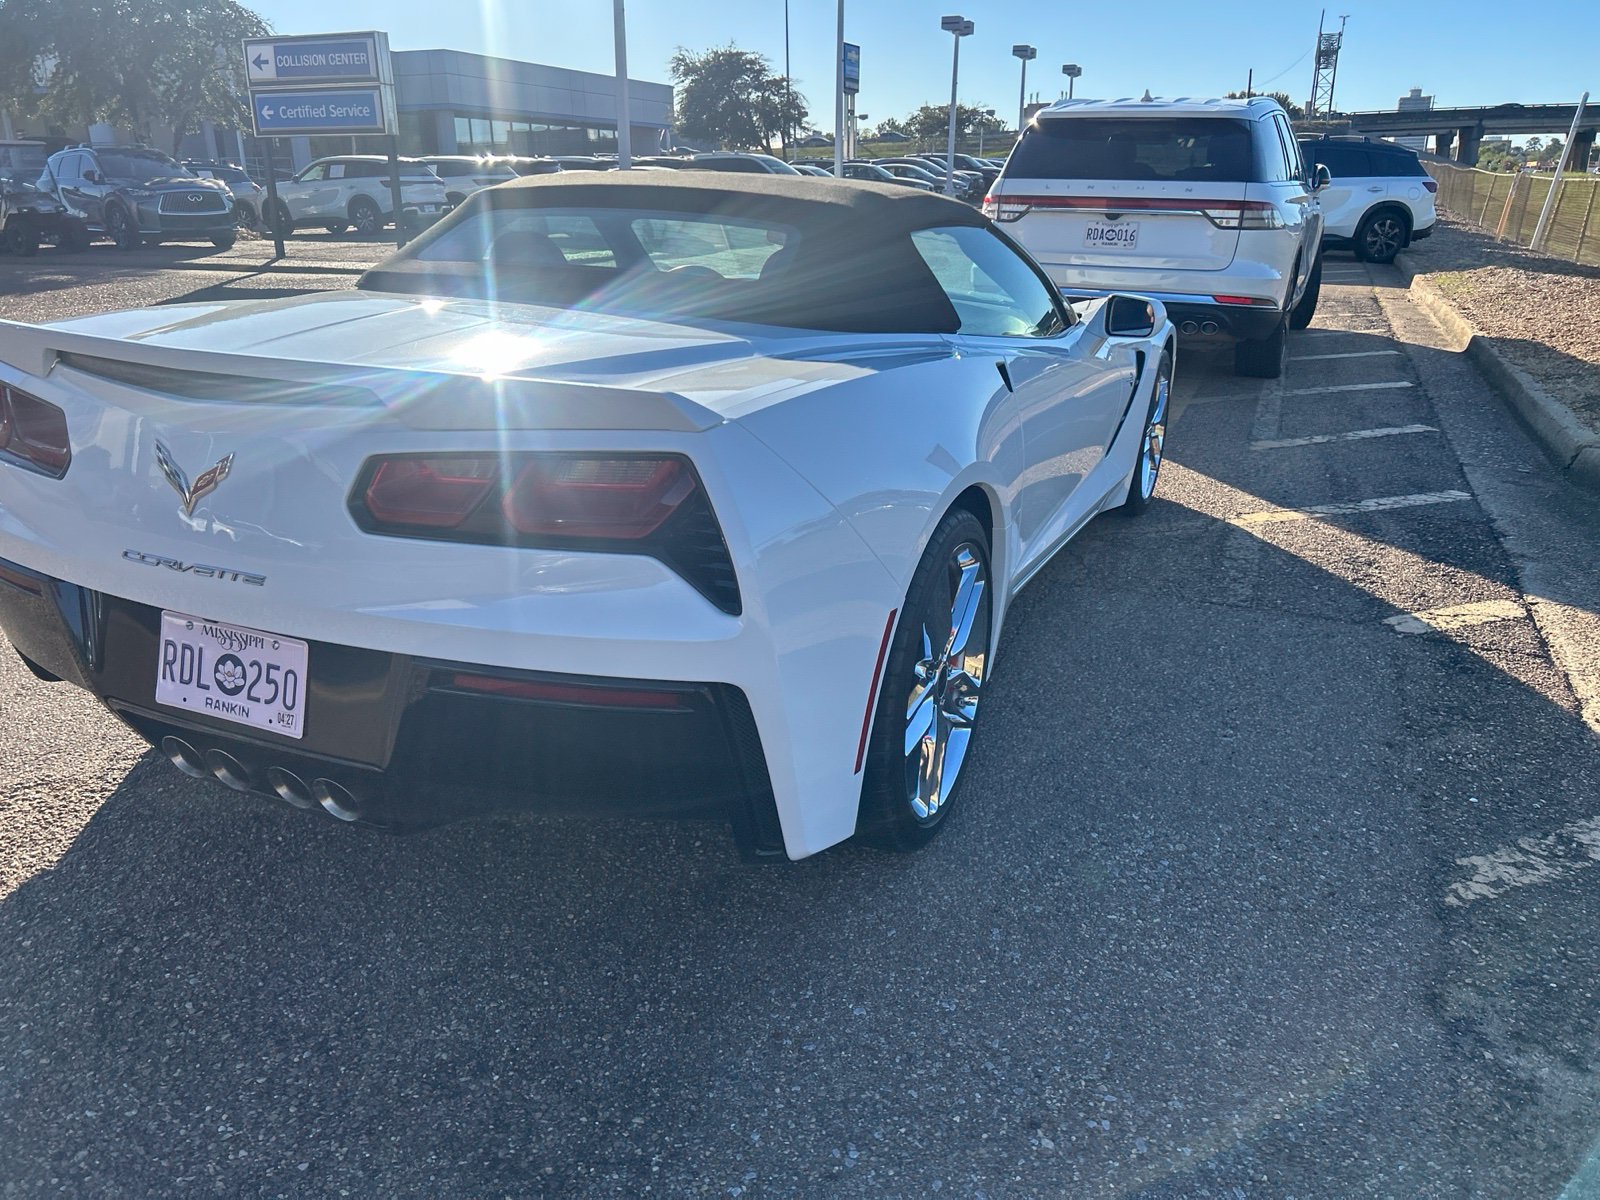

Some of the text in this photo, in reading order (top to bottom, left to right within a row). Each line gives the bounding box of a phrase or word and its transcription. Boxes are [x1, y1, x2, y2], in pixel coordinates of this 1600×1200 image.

[276, 52, 367, 67] COLLISION CENTER
[279, 103, 370, 119] Certified Service
[1086, 227, 1137, 241] RDA 016
[121, 549, 267, 587] CORVETTE
[200, 624, 265, 653] MISSISSIPPI
[162, 638, 298, 711] RDL 250
[205, 696, 250, 718] RANKIN
